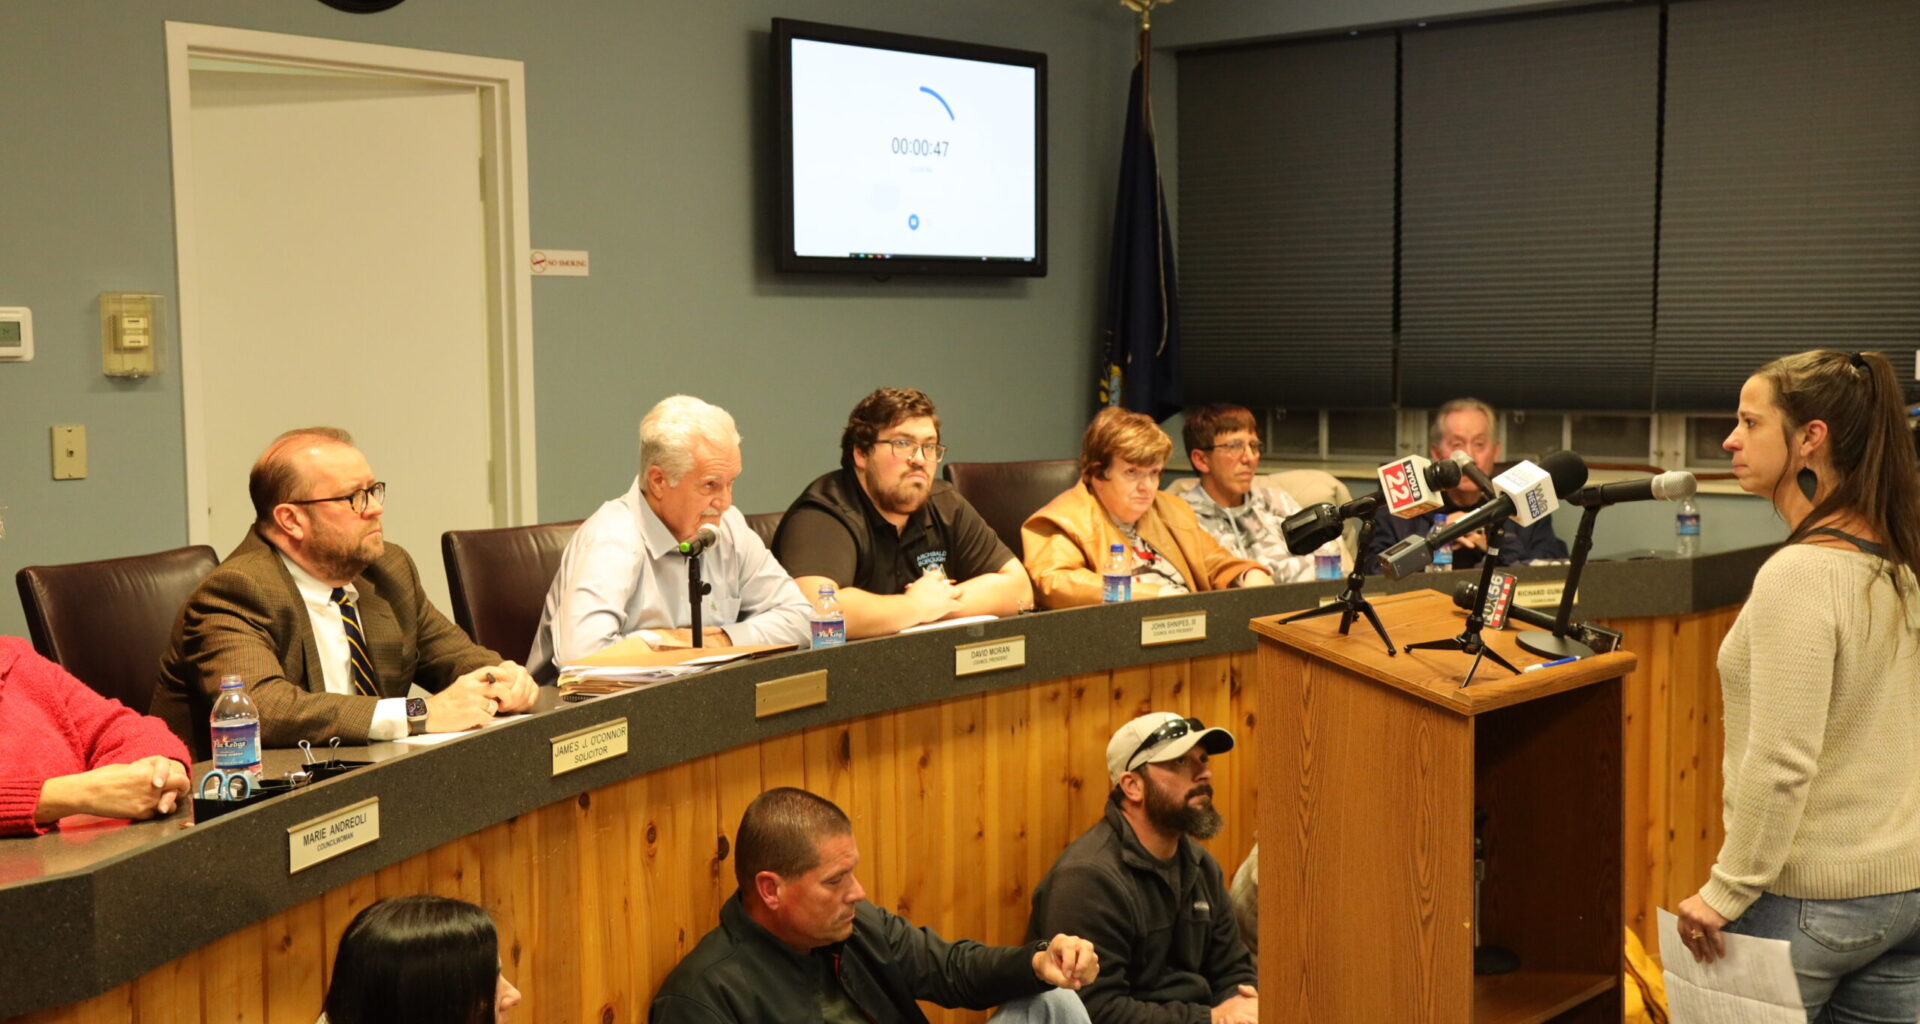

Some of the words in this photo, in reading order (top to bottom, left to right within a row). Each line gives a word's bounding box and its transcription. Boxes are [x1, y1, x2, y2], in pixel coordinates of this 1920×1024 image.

[892, 137, 949, 157] 00:00:47
[559, 259, 586, 267] SMOKING
[1385, 471, 1410, 503] 22
[1527, 491, 1539, 517] NEWS
[1151, 623, 1166, 631] JOHN
[971, 648, 988, 659] DAVID
[989, 645, 1010, 655] MORAN
[554, 741, 580, 758] JAMES
[591, 726, 626, 746] O'CONNOR
[574, 745, 608, 763] SOLICITOR
[303, 828, 326, 847] MARIE
[329, 812, 367, 836] ANDREOLI
[317, 832, 354, 852] COUNCILWOMAN
